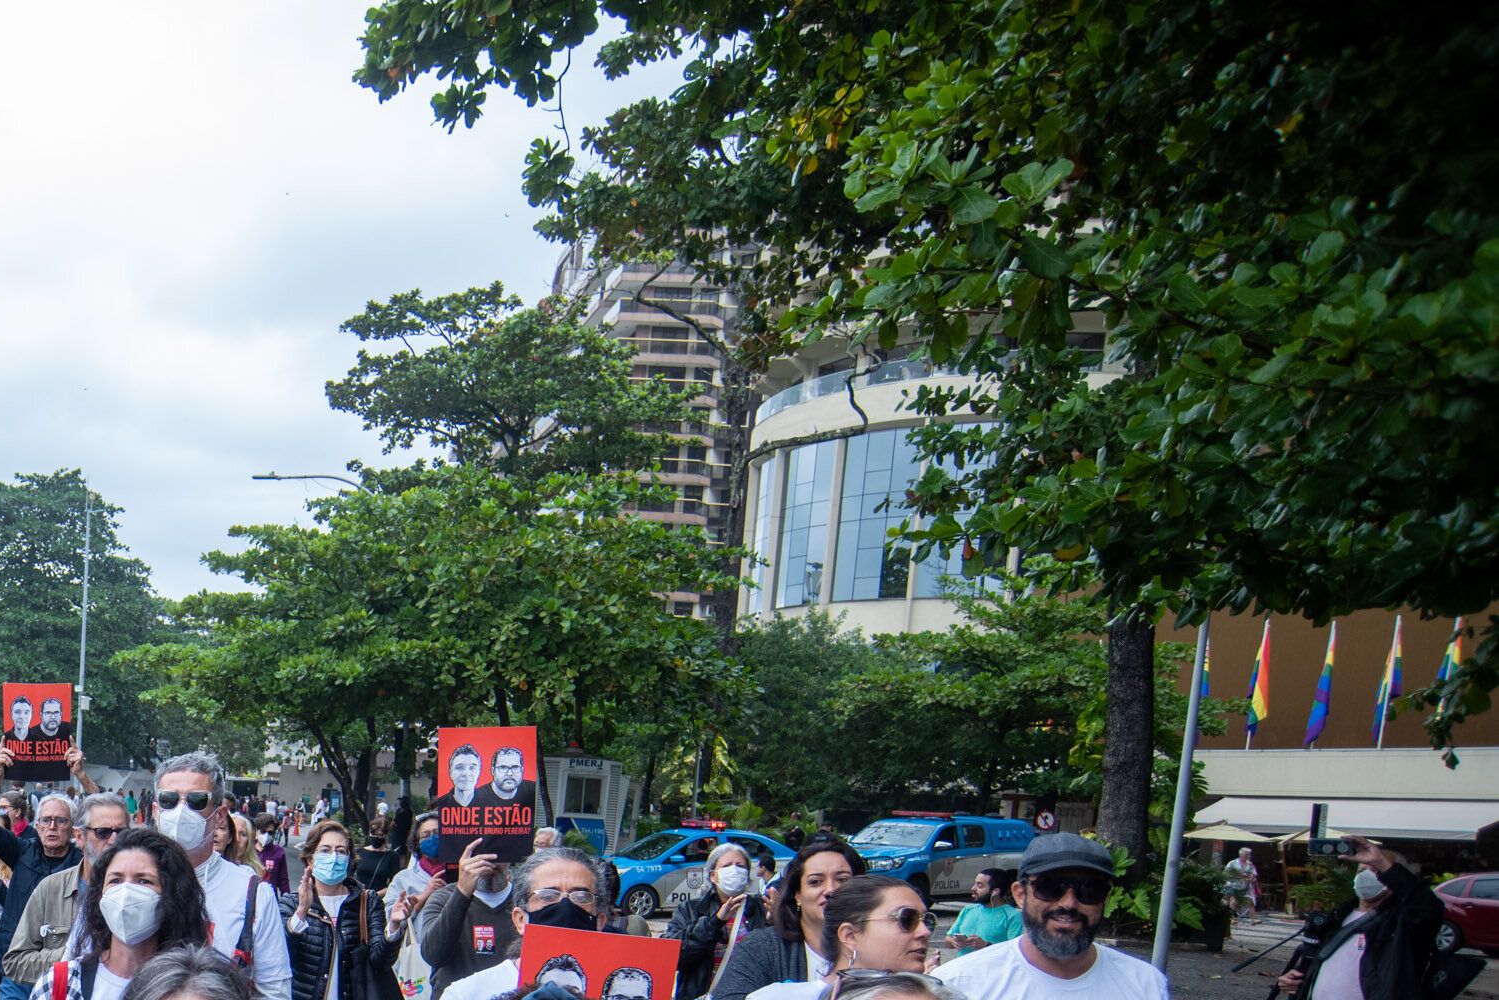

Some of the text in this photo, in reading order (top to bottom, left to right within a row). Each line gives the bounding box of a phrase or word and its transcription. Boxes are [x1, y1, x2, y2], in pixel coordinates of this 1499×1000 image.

[6, 738, 68, 755] ONDE ESTÃO
[569, 758, 603, 769] PMERJ
[441, 803, 532, 826] ONDE ESTÃO
[441, 827, 531, 835] DOM PHILLIPS E BRUNO PEREIRA?
[935, 880, 960, 889] POLÍCIA
